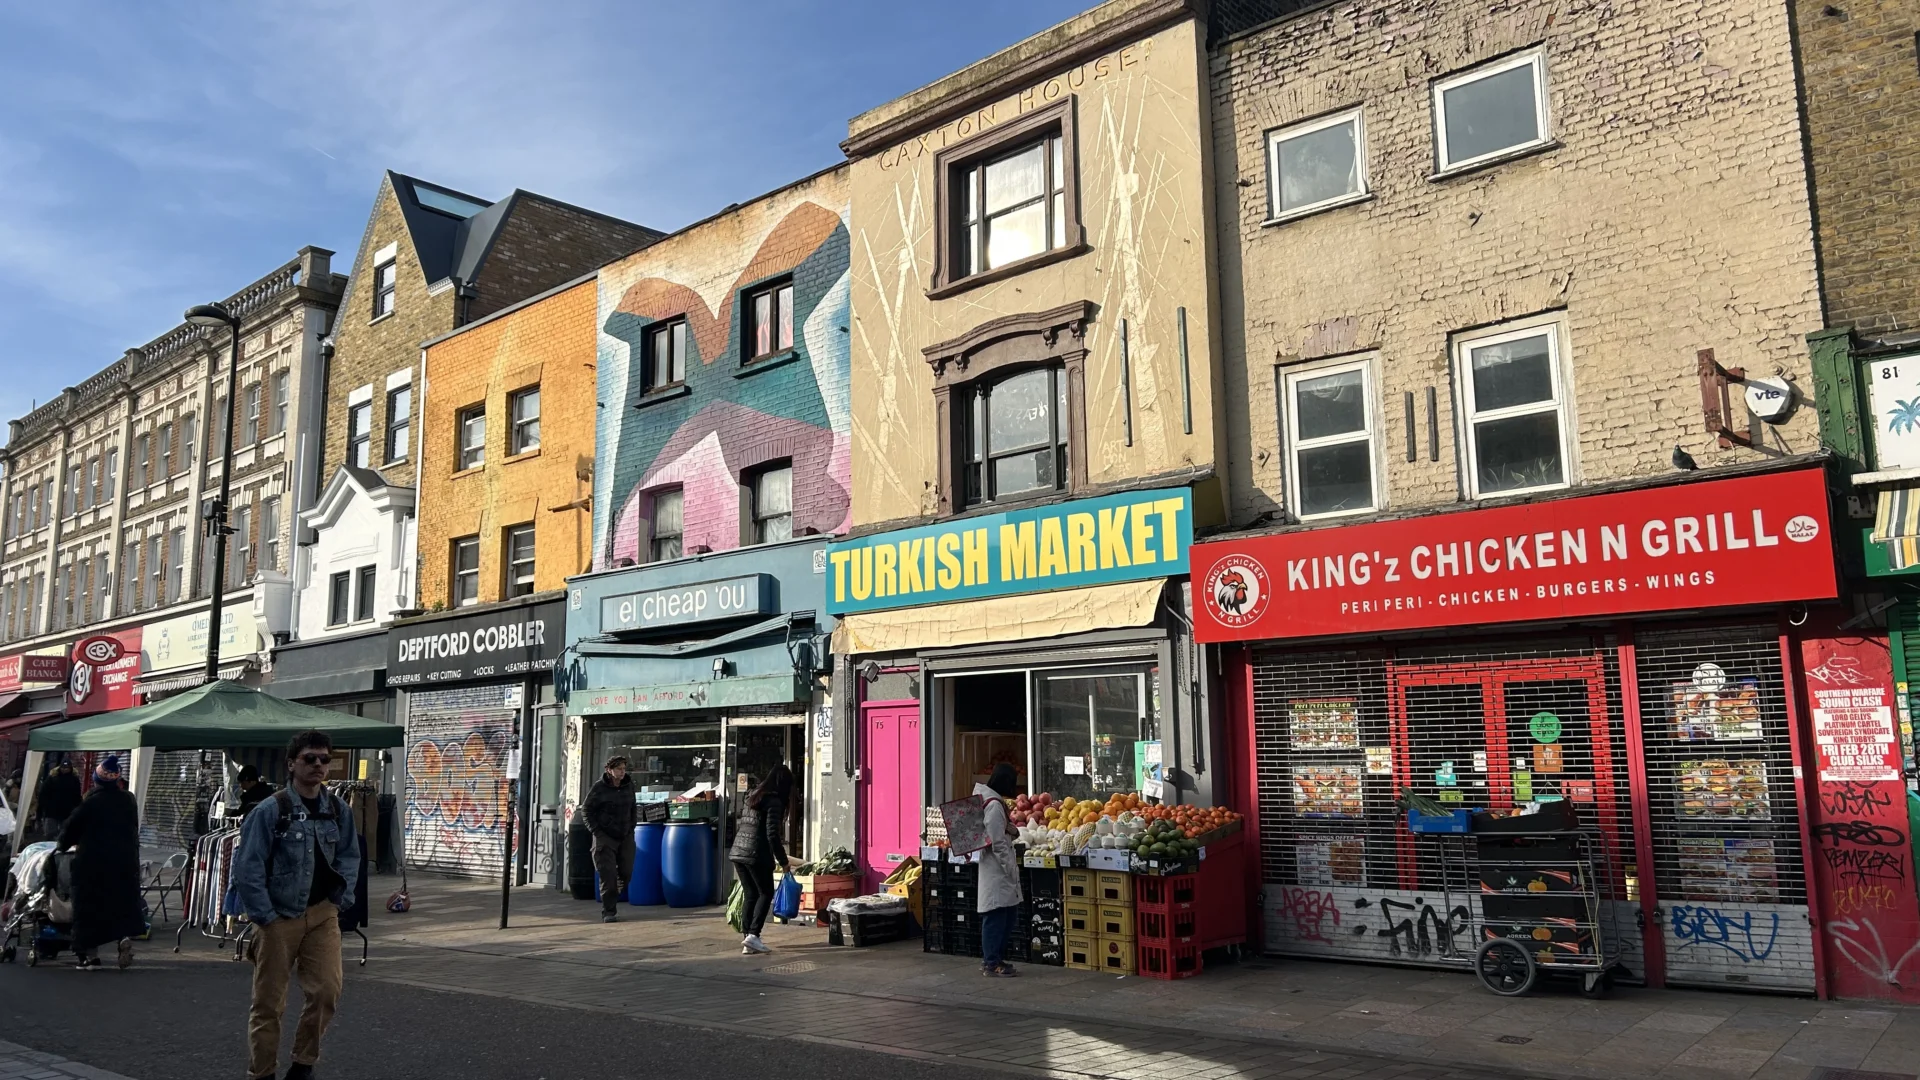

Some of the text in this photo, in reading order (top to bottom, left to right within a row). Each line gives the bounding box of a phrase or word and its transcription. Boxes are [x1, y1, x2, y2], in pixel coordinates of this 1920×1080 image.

[879, 104, 996, 171] CAXTON
[1755, 390, 1780, 401] vte
[830, 496, 1184, 602] TURKISH MARKET
[1287, 509, 1779, 592] KING'z CHICKEN N GRILL
[1227, 558, 1265, 580] CHICKEN
[1341, 570, 1715, 615] PERI PERI CHICKEN BURGERS WINGS
[619, 595, 636, 623] el
[642, 588, 707, 619] cheap
[1228, 608, 1260, 624] GRILL
[398, 620, 545, 662] DEPTFORD COBBLER
[33, 659, 58, 668] CAFE
[102, 671, 128, 685] EXCHANGE
[389, 675, 401, 684] SHOE
[402, 673, 421, 683] REPAIRS
[430, 671, 440, 681] KEY
[440, 669, 462, 679] CUTTING
[477, 666, 494, 676] LOCKS
[508, 661, 530, 673] LEATHER
[590, 696, 609, 706] LOVE
[613, 695, 628, 704] YOU
[654, 690, 684, 701] AFFORD
[1814, 687, 1885, 698] SOUTHERN WARFARE
[1819, 696, 1882, 708] SOUND CLASH
[875, 721, 884, 729] 75
[908, 720, 917, 729] 77
[1824, 720, 1881, 729] PLATINUM CARTEL
[1818, 727, 1890, 737] SOVEREIGN SYNDICATE
[1850, 735, 1876, 743] TUBBYS
[1822, 743, 1889, 756] FRI FEB 28TH
[1830, 755, 1884, 766] CLUB SILKS
